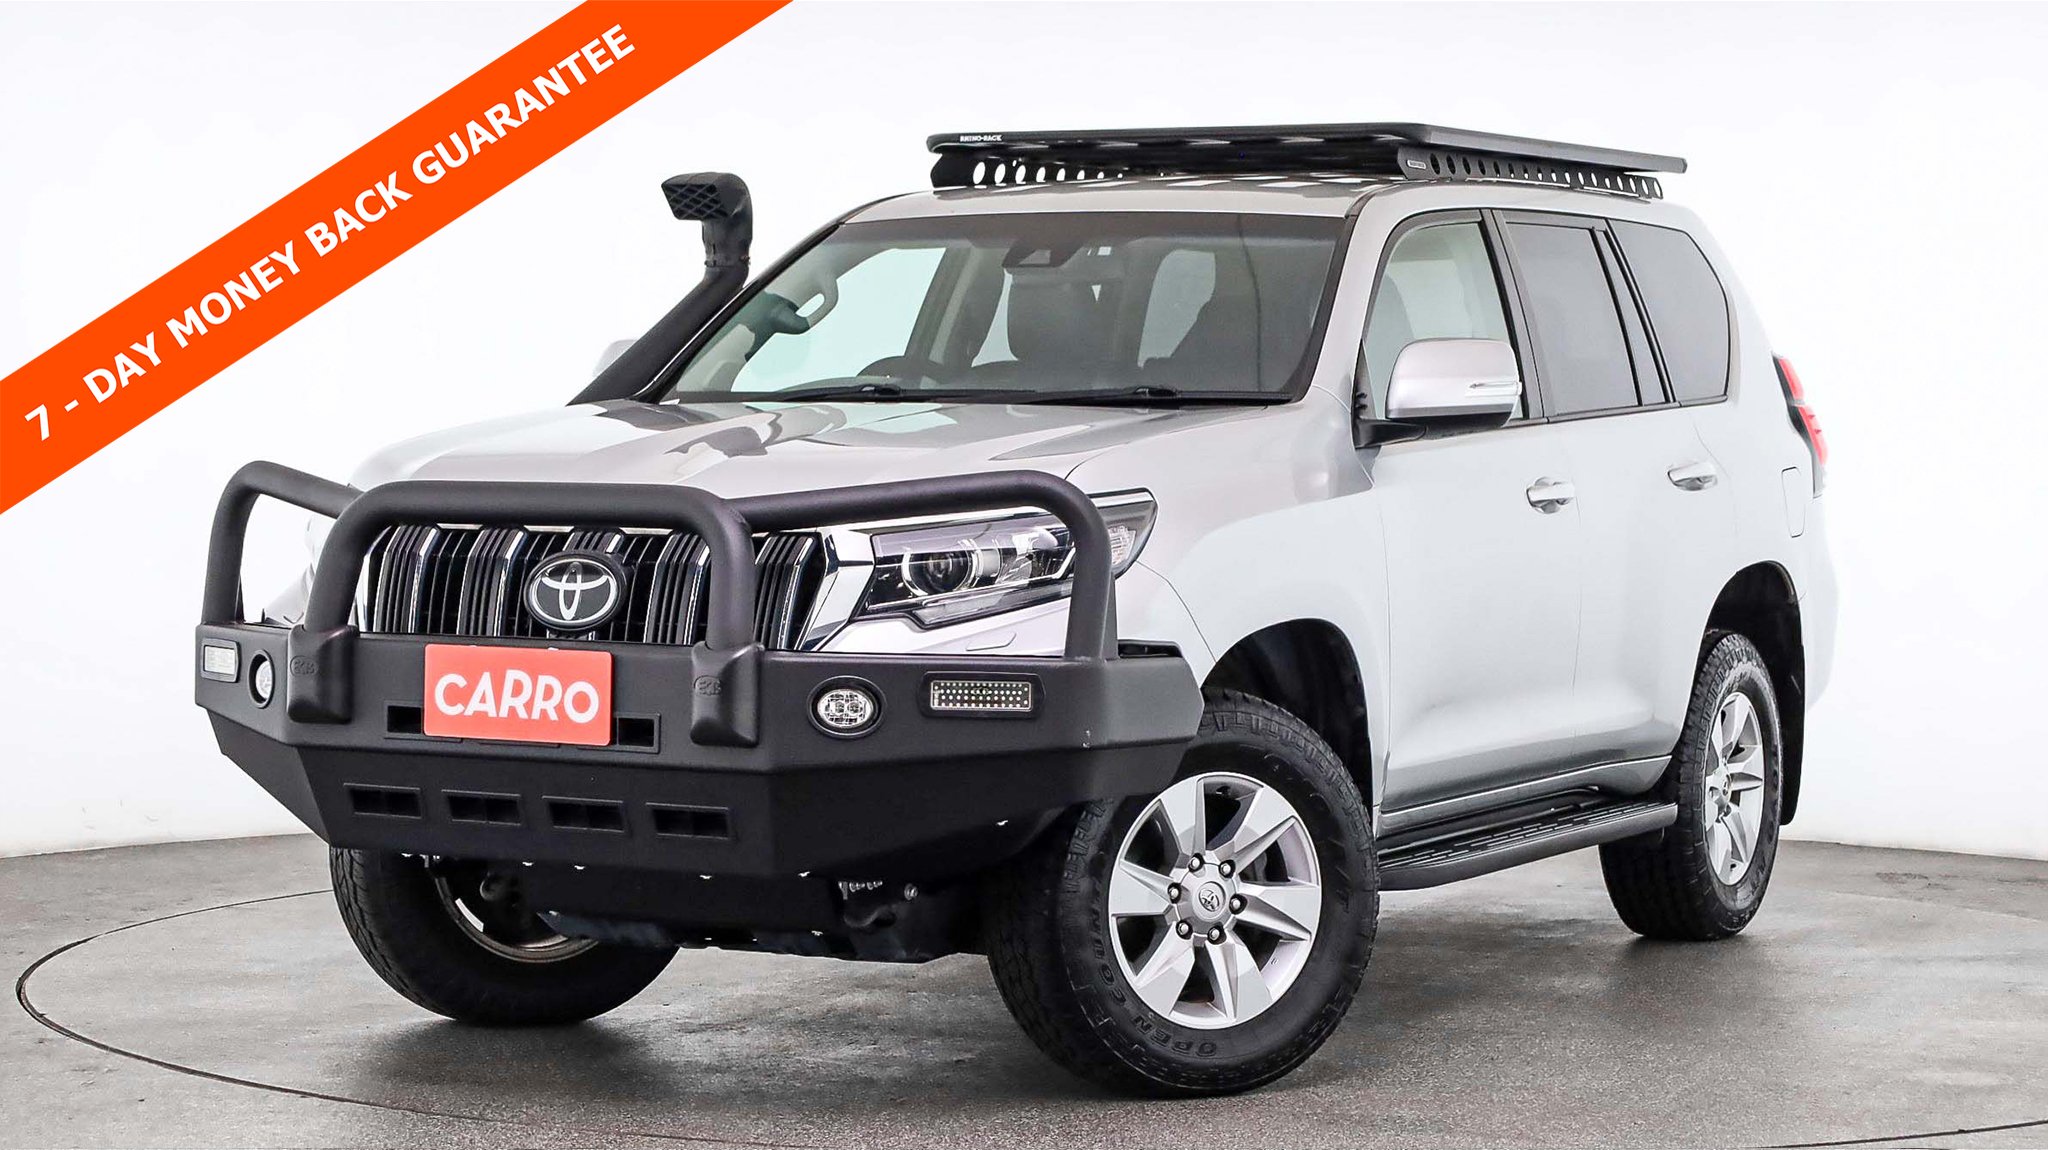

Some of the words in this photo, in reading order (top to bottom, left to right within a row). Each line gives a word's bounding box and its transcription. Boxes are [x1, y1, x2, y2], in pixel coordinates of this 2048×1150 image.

[959, 134, 1003, 142] RHINO-RACK
[433, 668, 600, 725] CARRO
[1132, 1015, 1218, 1059] OPEN
